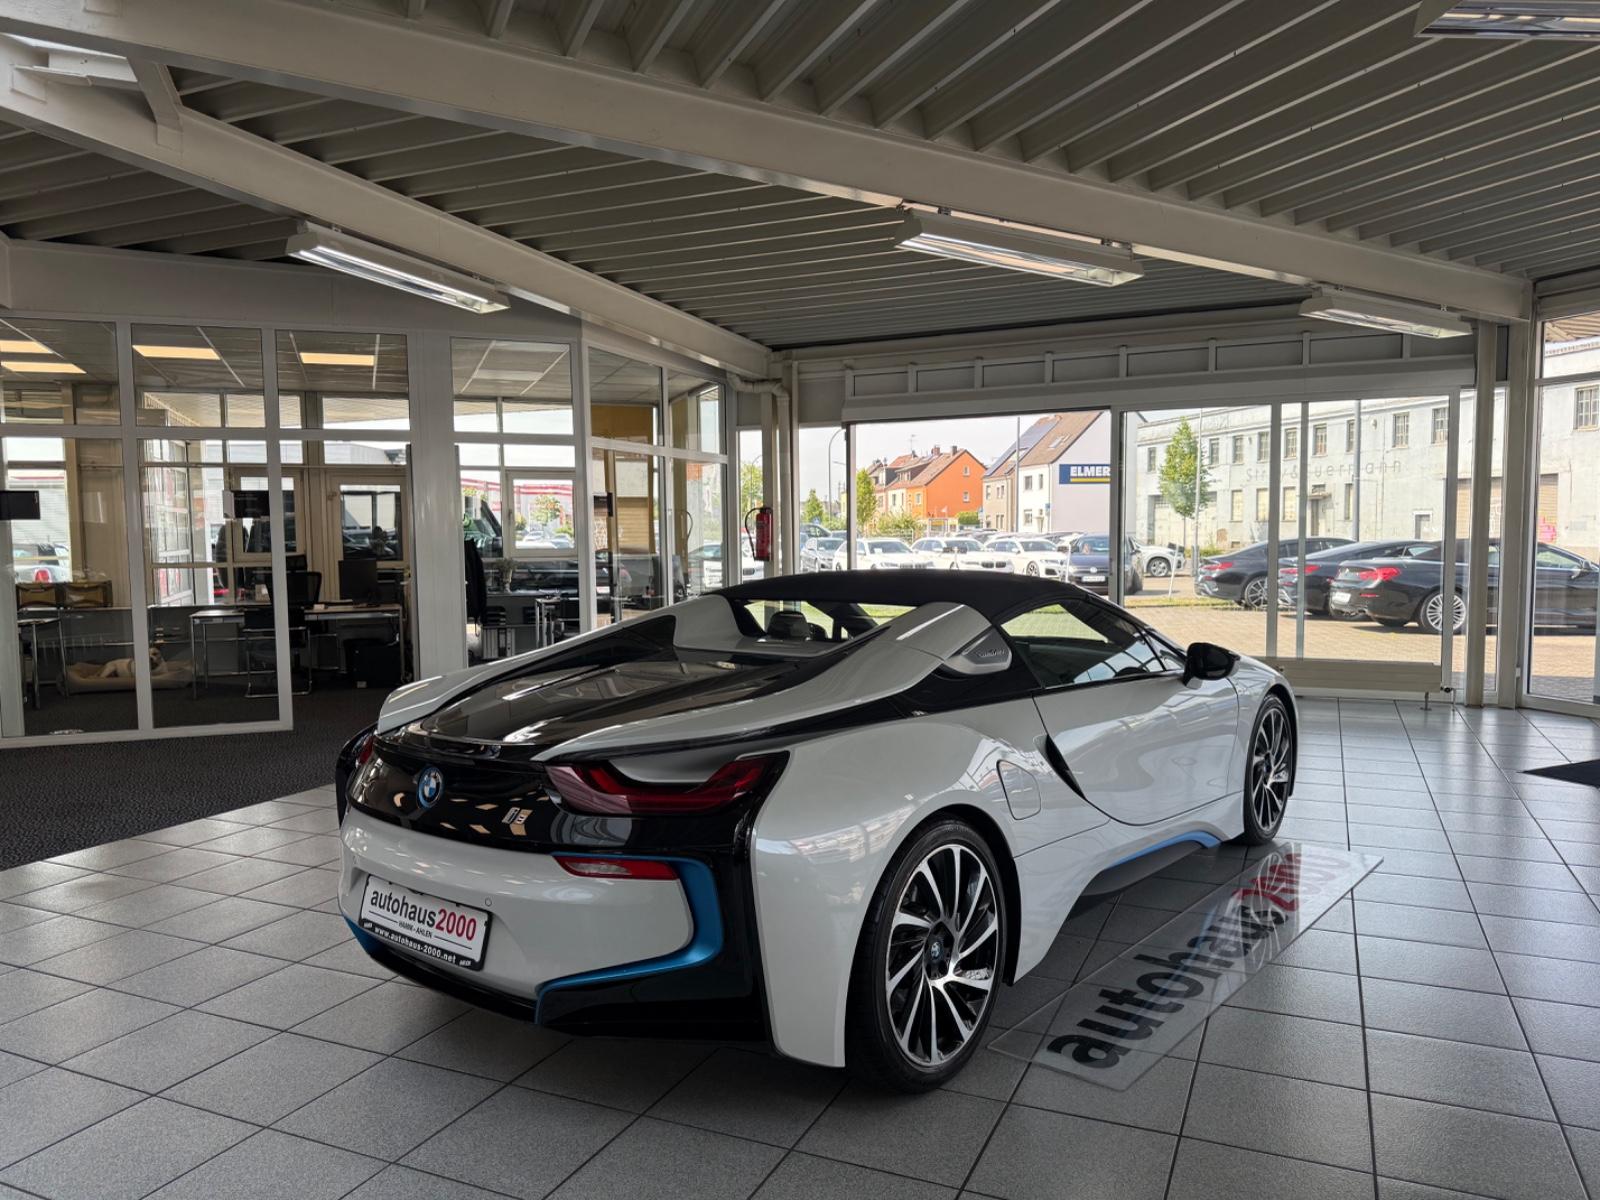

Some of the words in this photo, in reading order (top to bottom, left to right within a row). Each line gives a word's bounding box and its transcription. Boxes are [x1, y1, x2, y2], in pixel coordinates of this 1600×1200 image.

[1070, 466, 1111, 477] ELMER
[370, 890, 477, 942] autohaus2000
[374, 926, 457, 963] www.autohaus-2000.net
